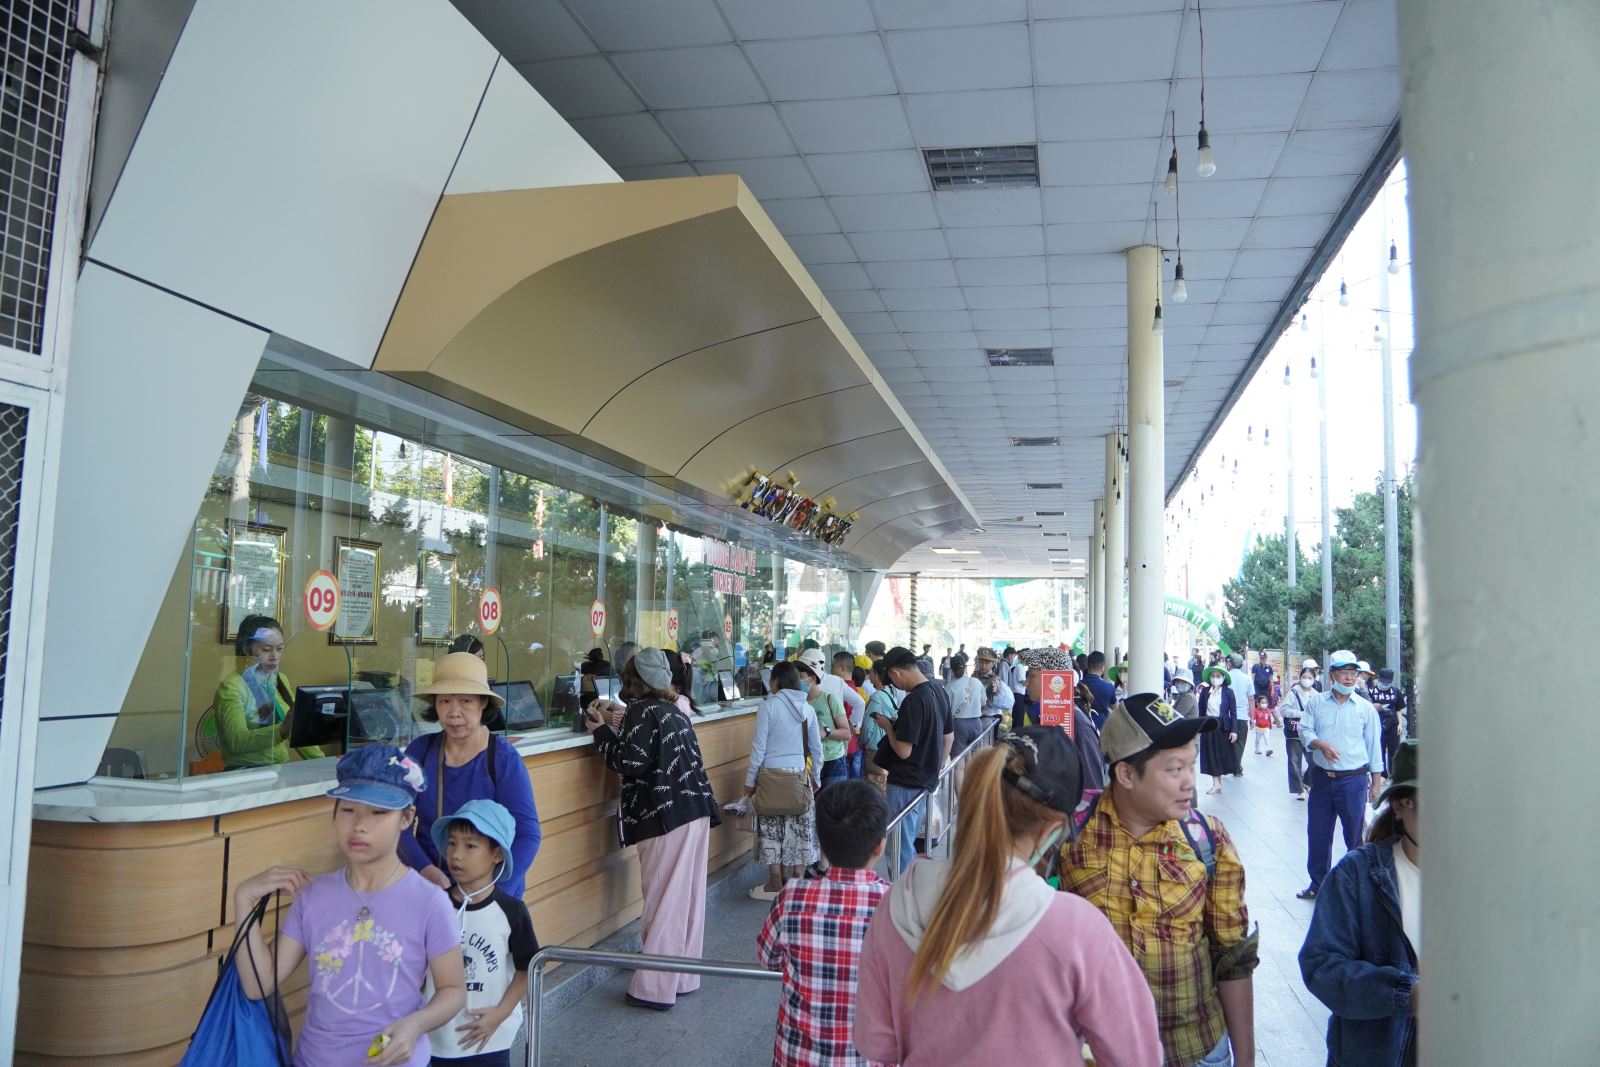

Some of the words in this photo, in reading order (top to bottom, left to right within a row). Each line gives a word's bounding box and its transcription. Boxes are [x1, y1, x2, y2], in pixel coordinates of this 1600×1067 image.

[712, 570, 734, 595] TICKET
[309, 586, 335, 612] 09
[481, 601, 498, 620] 08
[592, 610, 604, 627] 07
[668, 616, 677, 630] 06
[469, 933, 498, 973] CHAMPS
